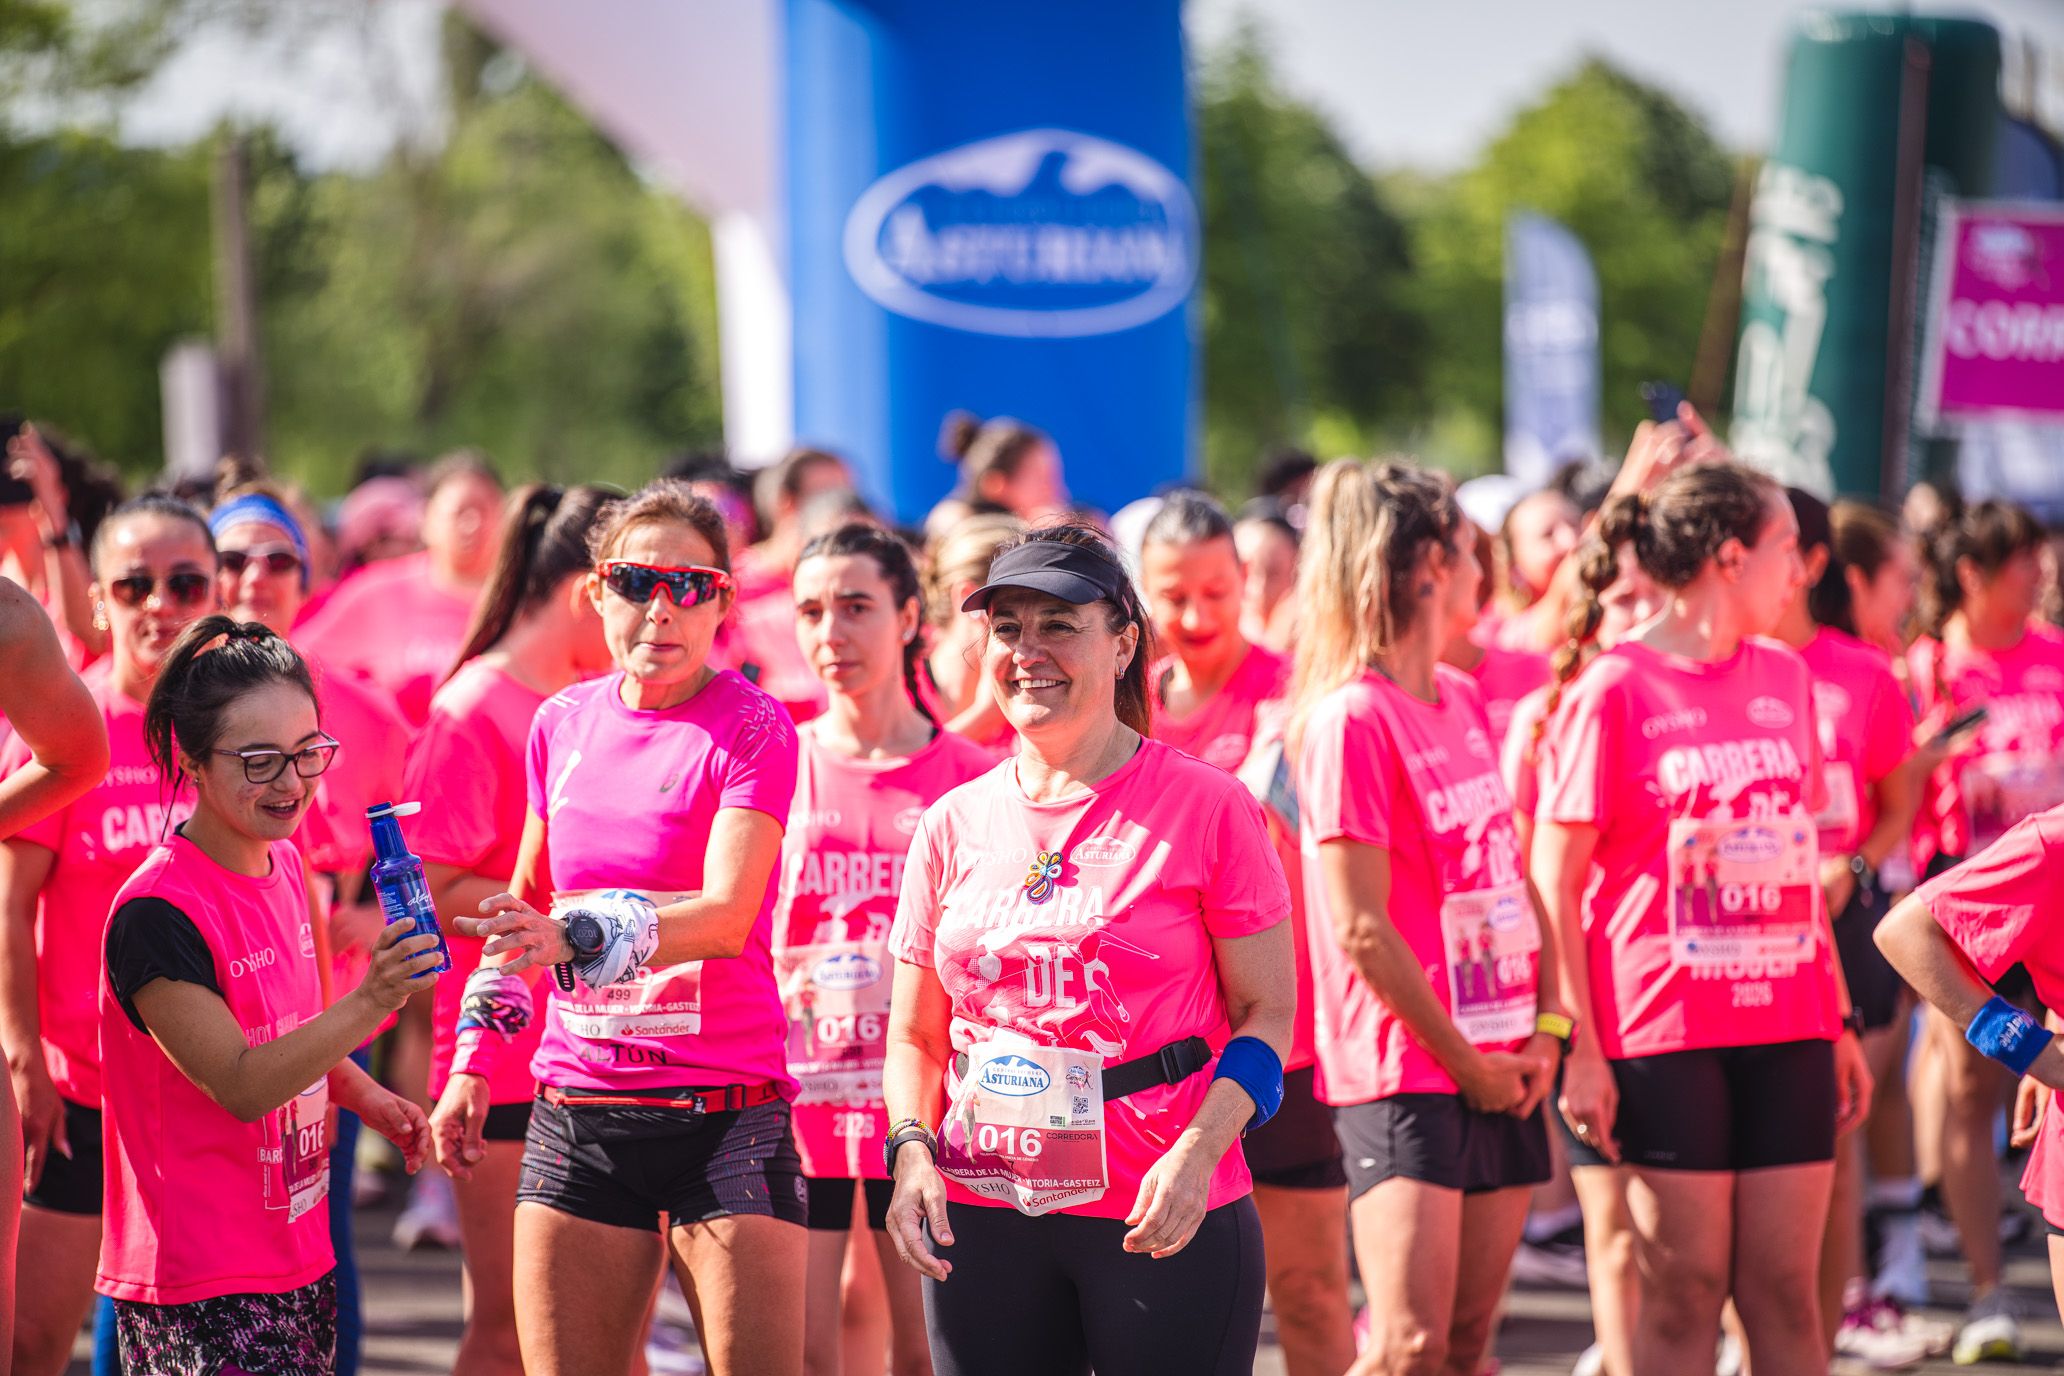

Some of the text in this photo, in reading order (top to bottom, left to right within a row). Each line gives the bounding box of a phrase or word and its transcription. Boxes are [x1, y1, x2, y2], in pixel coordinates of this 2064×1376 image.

[97, 765, 158, 788] YSHO
[1657, 737, 1802, 796] CARRERA
[787, 850, 907, 896] CARRER
[1721, 883, 1782, 912] 016
[230, 947, 275, 977] OYSHO
[1023, 943, 1078, 1008] DE
[606, 989, 631, 1001] 499
[636, 1024, 691, 1036] Santander
[817, 1014, 882, 1045] 016
[981, 1067, 1044, 1088] ASTURIANA
[978, 1125, 1043, 1157] 016
[1046, 1132, 1098, 1140] CORREDORA
[941, 1166, 976, 1176] CARRERA
[976, 1168, 988, 1176] DE
[988, 1168, 1000, 1176] LA
[1025, 1178, 1101, 1190] VITORIA-GASTEIZ
[968, 1183, 1011, 1195] YSHO
[1032, 1188, 1088, 1208] Santander
